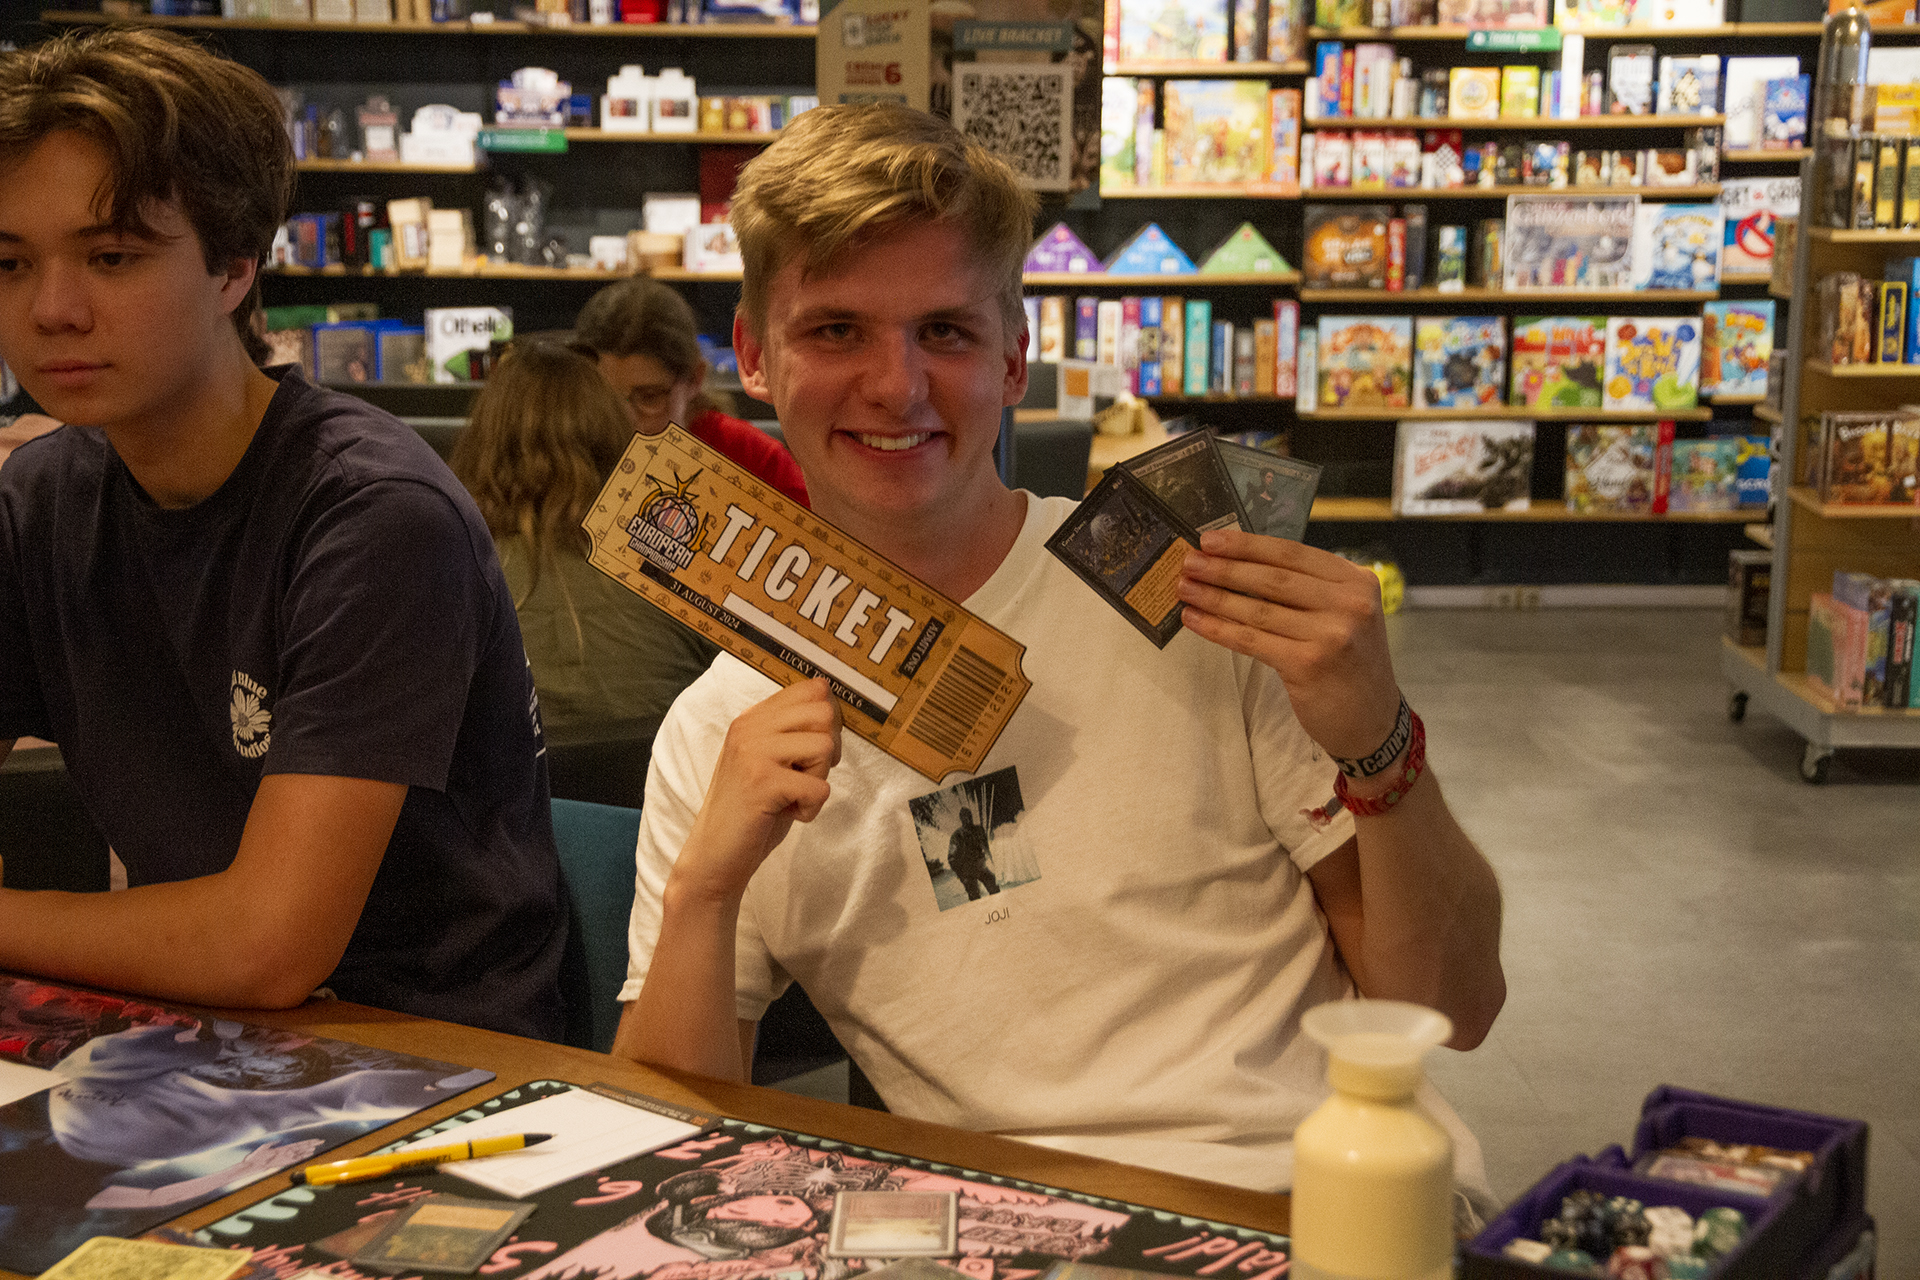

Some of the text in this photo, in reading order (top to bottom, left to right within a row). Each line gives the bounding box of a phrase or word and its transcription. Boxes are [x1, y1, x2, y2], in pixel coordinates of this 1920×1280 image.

[999, 26, 1063, 45] BRACKET
[884, 61, 902, 85] 6
[627, 515, 694, 570] EUROPEAN
[629, 537, 677, 573] CHAMPIONSHIP
[670, 581, 741, 630] 31 AUGUST 2024
[709, 503, 914, 666] TICKET
[904, 622, 939, 674] ADMIT ONE
[779, 649, 813, 676] LUCKY
[831, 681, 860, 704] DECK
[984, 907, 1011, 926] JOJI
